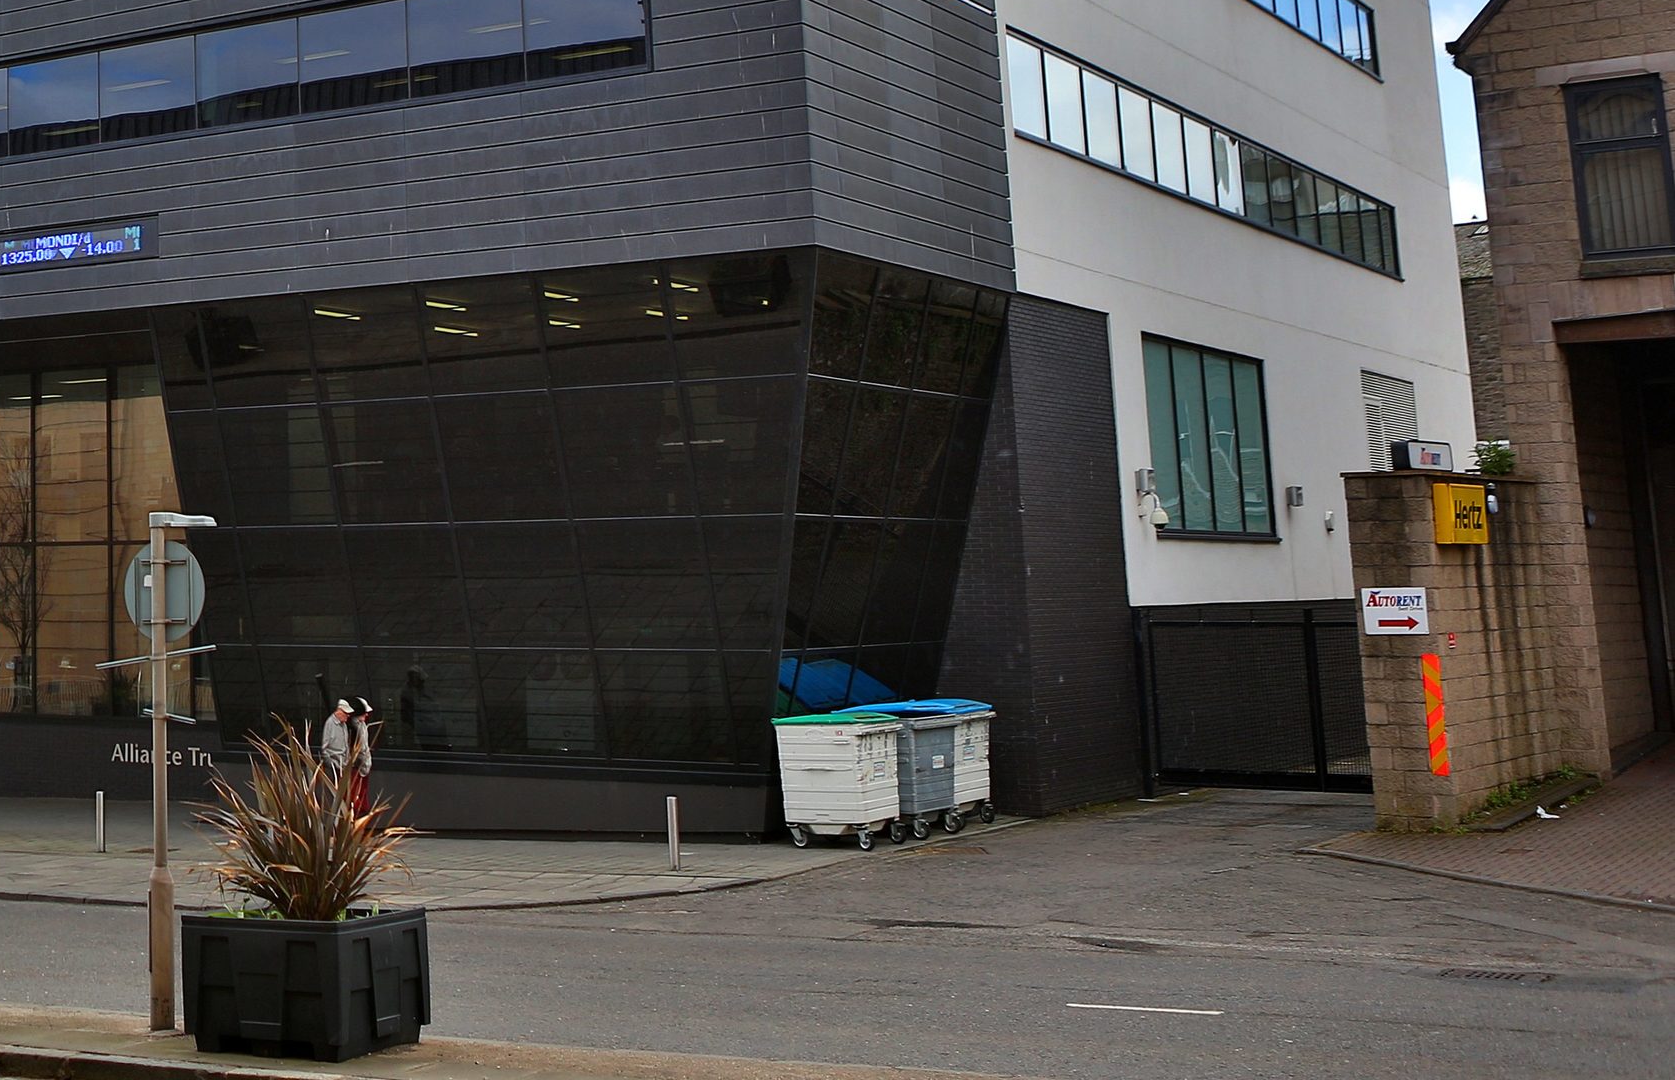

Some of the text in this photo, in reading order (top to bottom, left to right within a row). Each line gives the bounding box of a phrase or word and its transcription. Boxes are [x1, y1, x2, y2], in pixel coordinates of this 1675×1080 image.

[1, 240, 124, 265] 1325.00 -14.00
[35, 232, 91, 249] MONDI/d
[1454, 499, 1483, 530] Hertz
[1365, 592, 1422, 608] AUTORENT
[110, 742, 183, 766] Alliace
